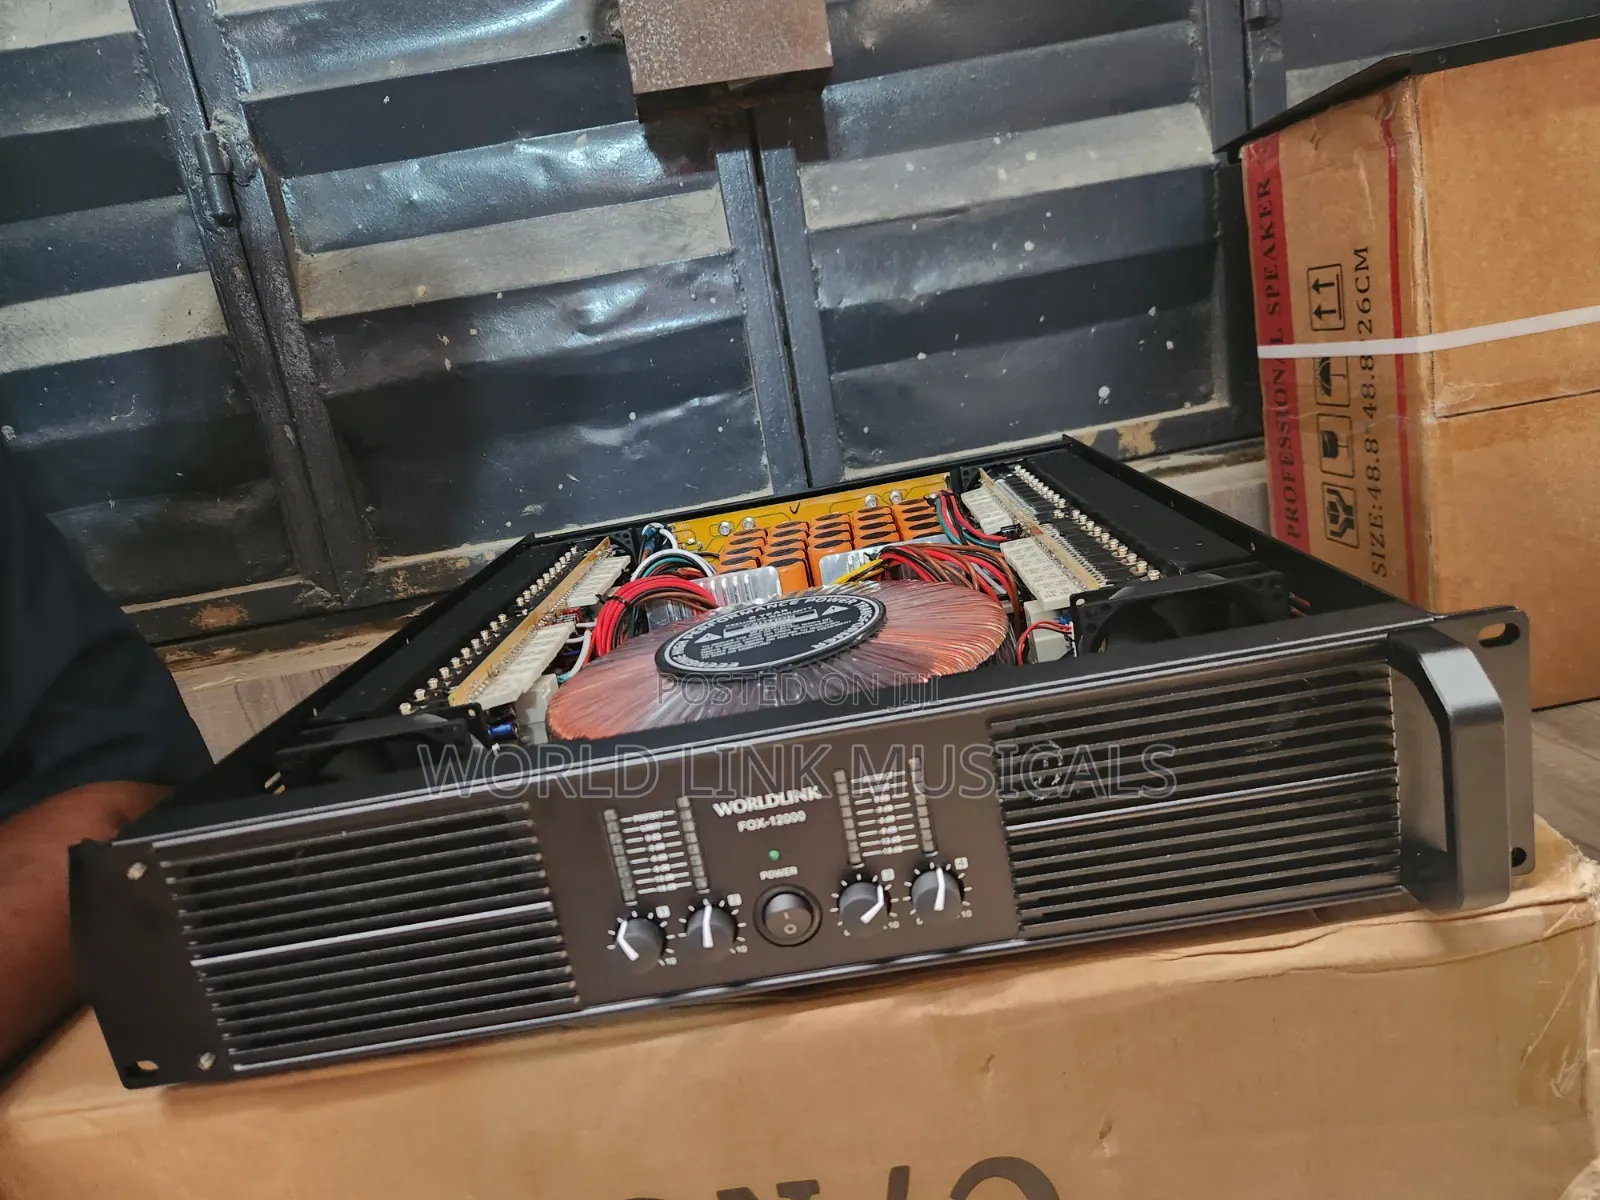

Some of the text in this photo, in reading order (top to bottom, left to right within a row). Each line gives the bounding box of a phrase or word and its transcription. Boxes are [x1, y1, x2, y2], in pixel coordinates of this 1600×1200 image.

[1257, 177, 1301, 539] PROFESSIONL SPEAKER
[1354, 246, 1387, 577] SIZE:48.848.826CM
[804, 597, 858, 605] POWER
[712, 785, 822, 817] WORLDLINK
[737, 810, 806, 832] FOX-12000
[760, 866, 798, 880] POWER
